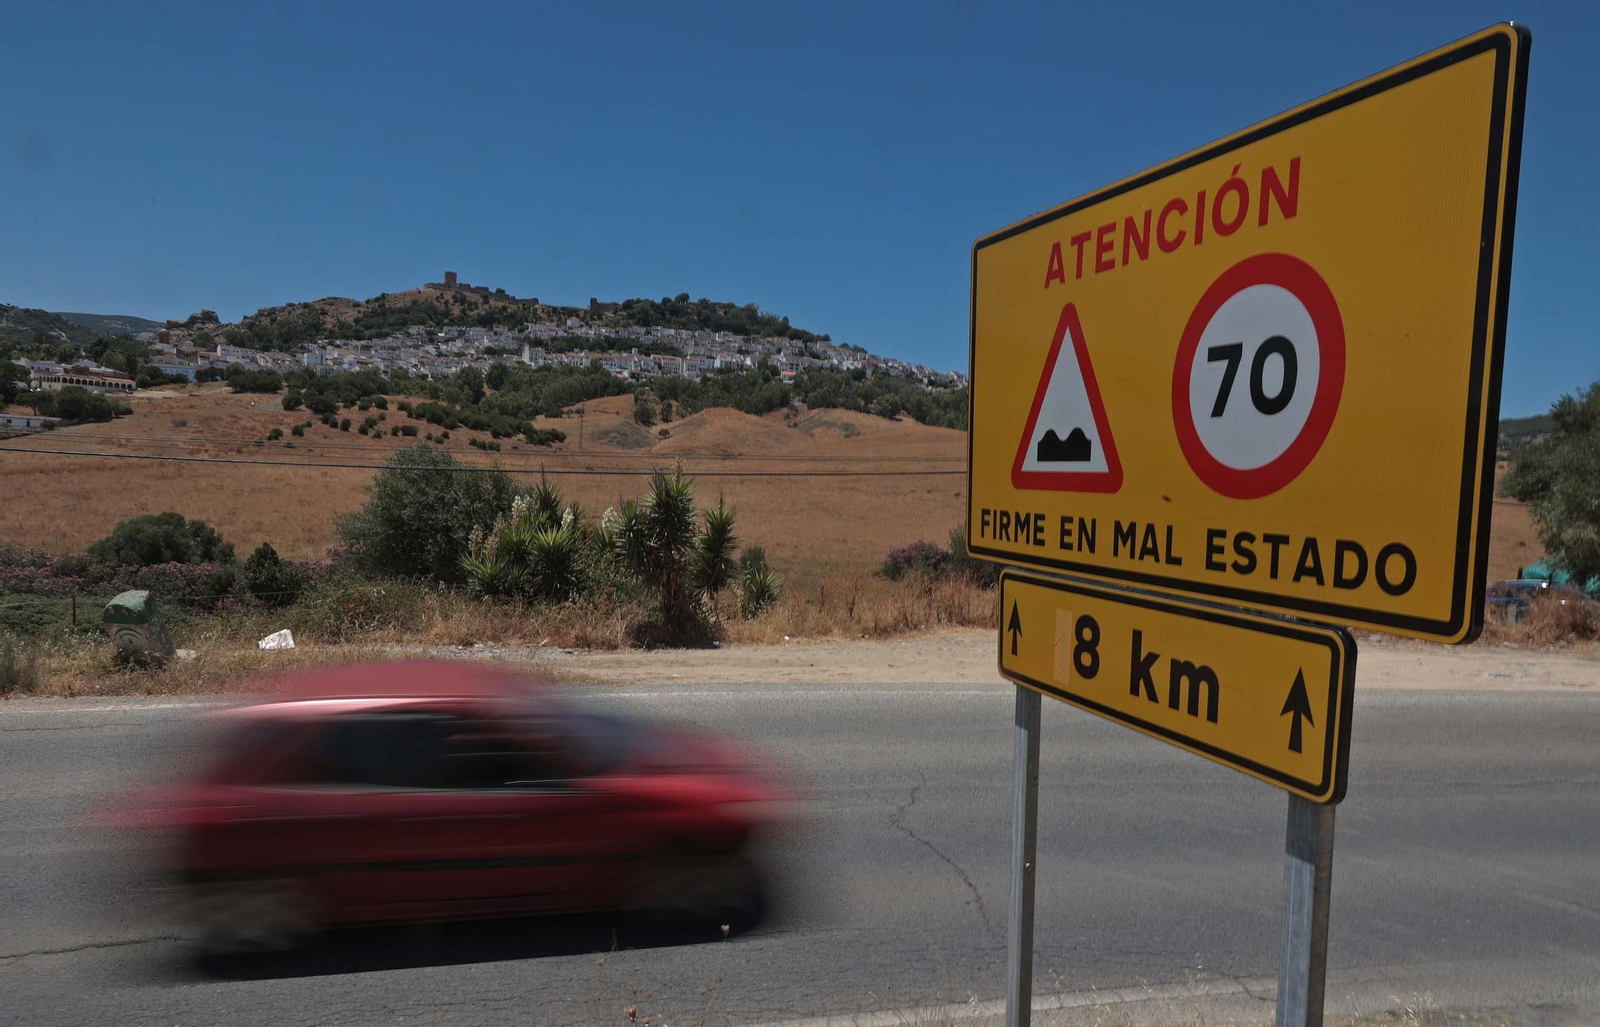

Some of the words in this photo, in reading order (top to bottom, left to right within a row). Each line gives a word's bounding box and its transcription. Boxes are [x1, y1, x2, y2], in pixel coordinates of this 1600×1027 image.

[1045, 157, 1301, 288] ATENCIÓN
[1207, 335, 1298, 418] 70
[980, 508, 1046, 546] FIRME
[1059, 515, 1097, 554] EN
[1113, 521, 1183, 566] MAL
[1205, 529, 1418, 595] ESTADO
[1074, 614, 1101, 679] 8
[1130, 629, 1219, 724] km
